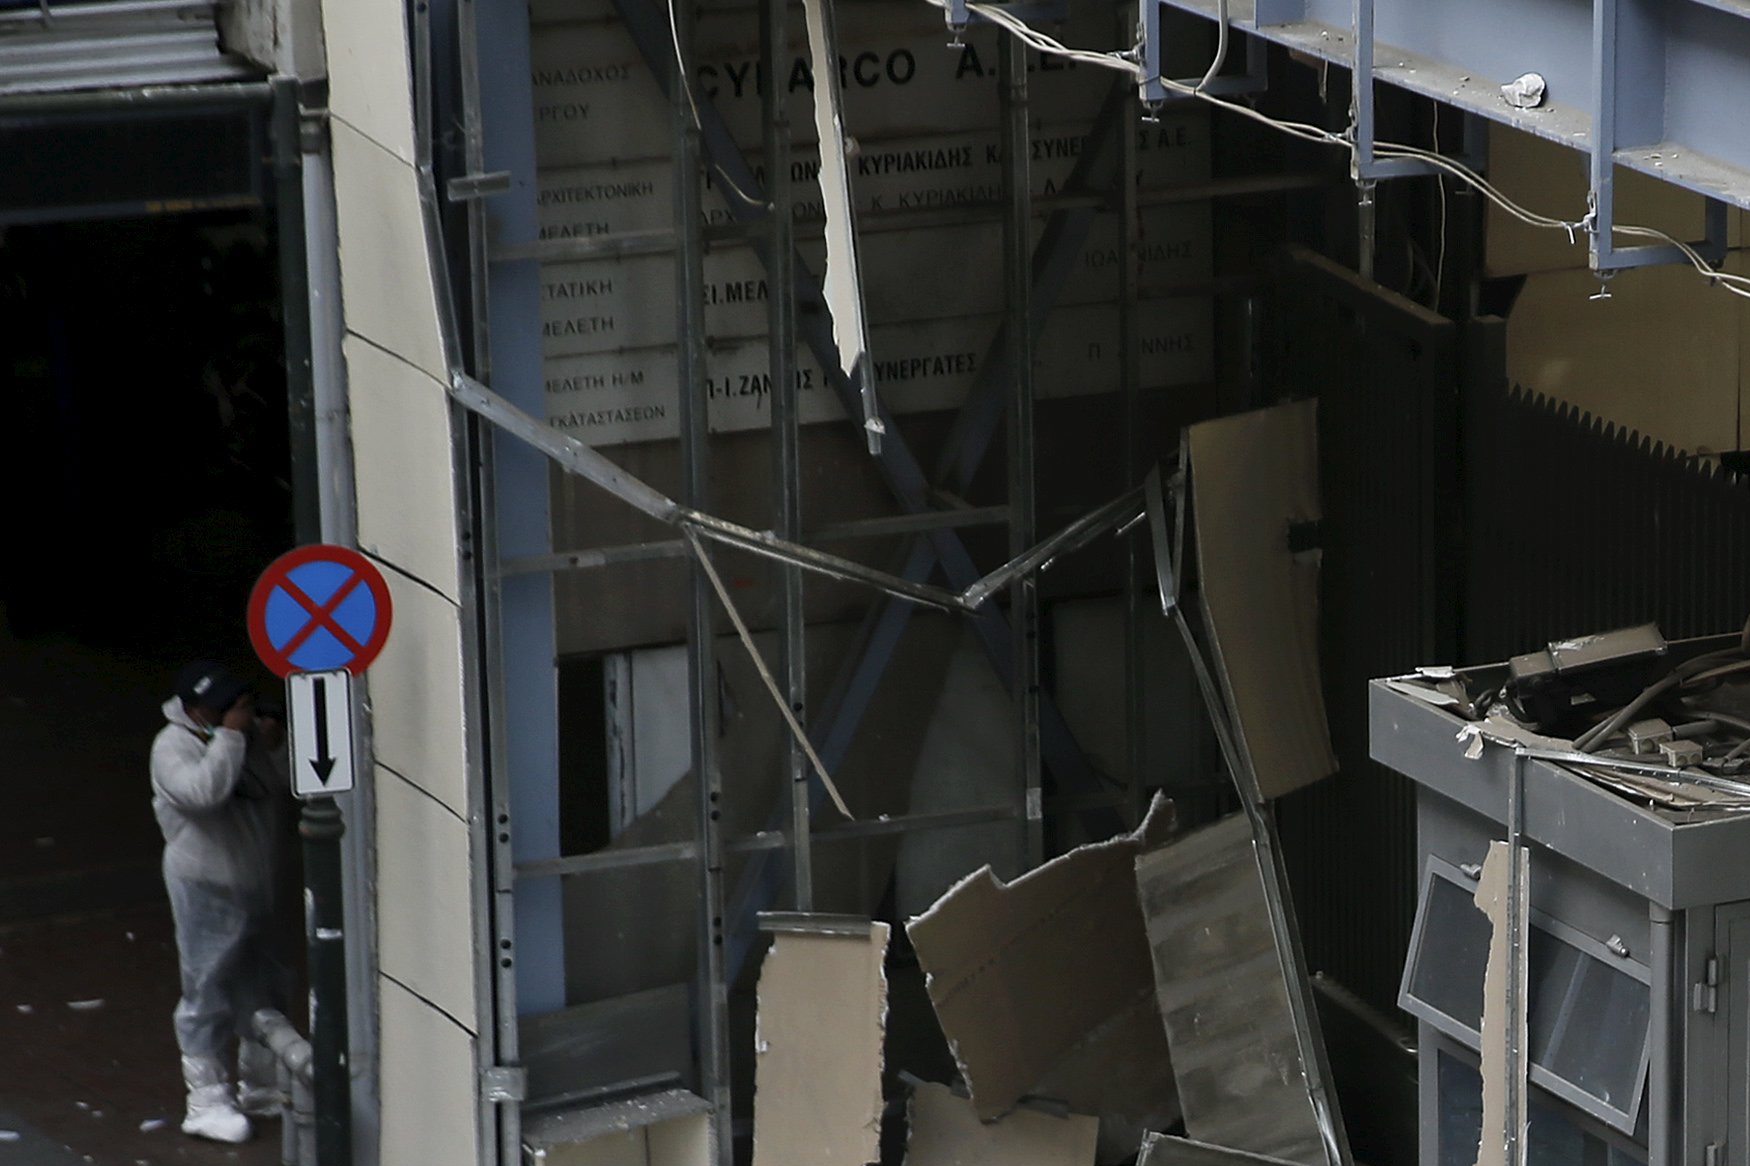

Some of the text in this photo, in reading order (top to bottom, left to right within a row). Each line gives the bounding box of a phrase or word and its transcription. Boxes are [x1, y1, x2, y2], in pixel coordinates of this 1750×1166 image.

[697, 50, 915, 98] CYACO
[538, 103, 589, 122] ΡΓΟΥ
[858, 145, 974, 177] ΚΥΡΙΑΚΙΔΗΣ
[537, 181, 653, 206] ΡΧΙΤΕΚΤΟΝΙΚΗ
[899, 184, 1006, 208] ΚΥΡΙΑΚΙΔΗ
[1085, 240, 1192, 268] ΙΩΑΝΙΔΗΣ
[542, 279, 613, 301] ΤΑΤΙΚΗ
[1139, 333, 1194, 355] ΝΝΗΣ
[873, 352, 977, 382] ΥΝΕΡΓΑΤΕΣ
